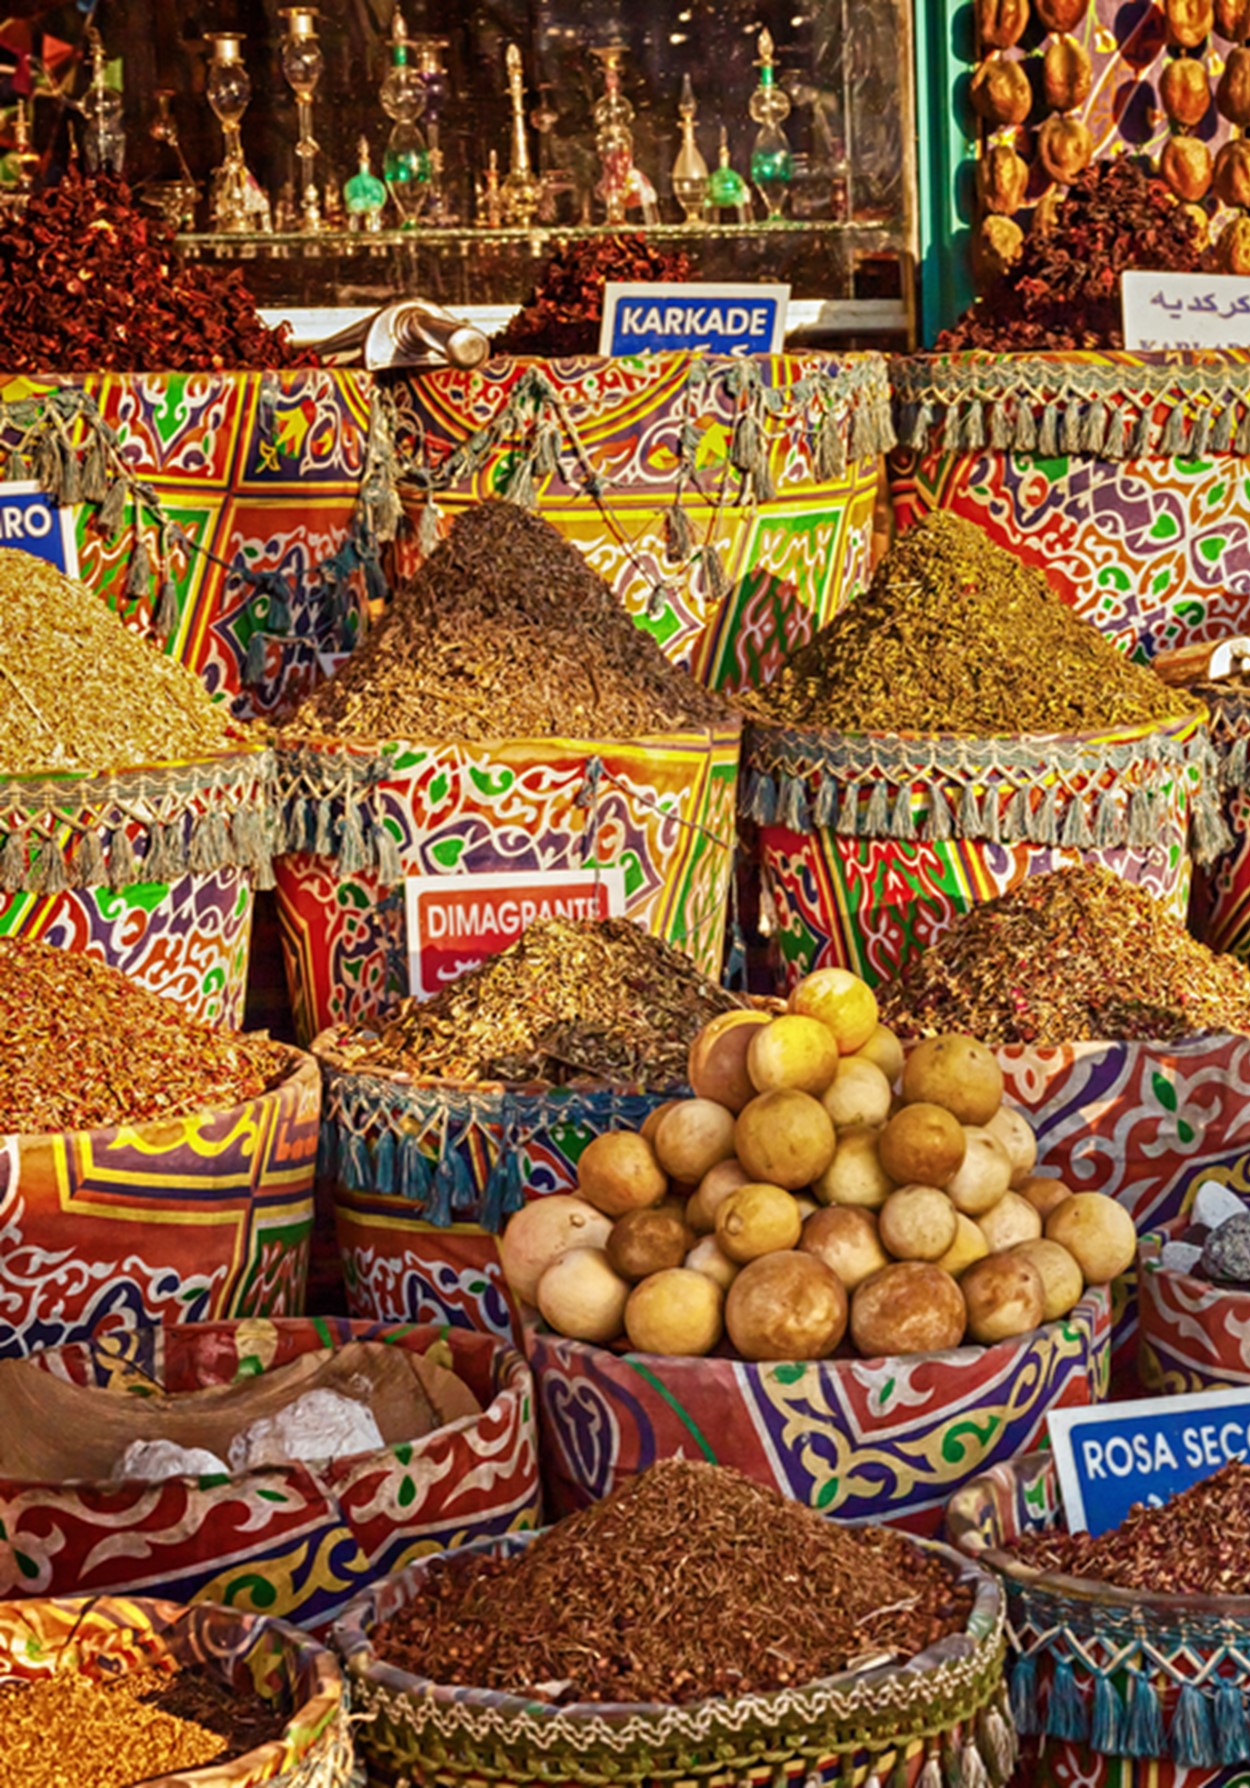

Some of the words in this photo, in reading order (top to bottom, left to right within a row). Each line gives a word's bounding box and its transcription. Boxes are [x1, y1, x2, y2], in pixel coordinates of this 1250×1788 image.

[621, 306, 768, 336] KARKADE
[0, 503, 53, 539] RO
[1082, 1432, 1179, 1481] ROSA
